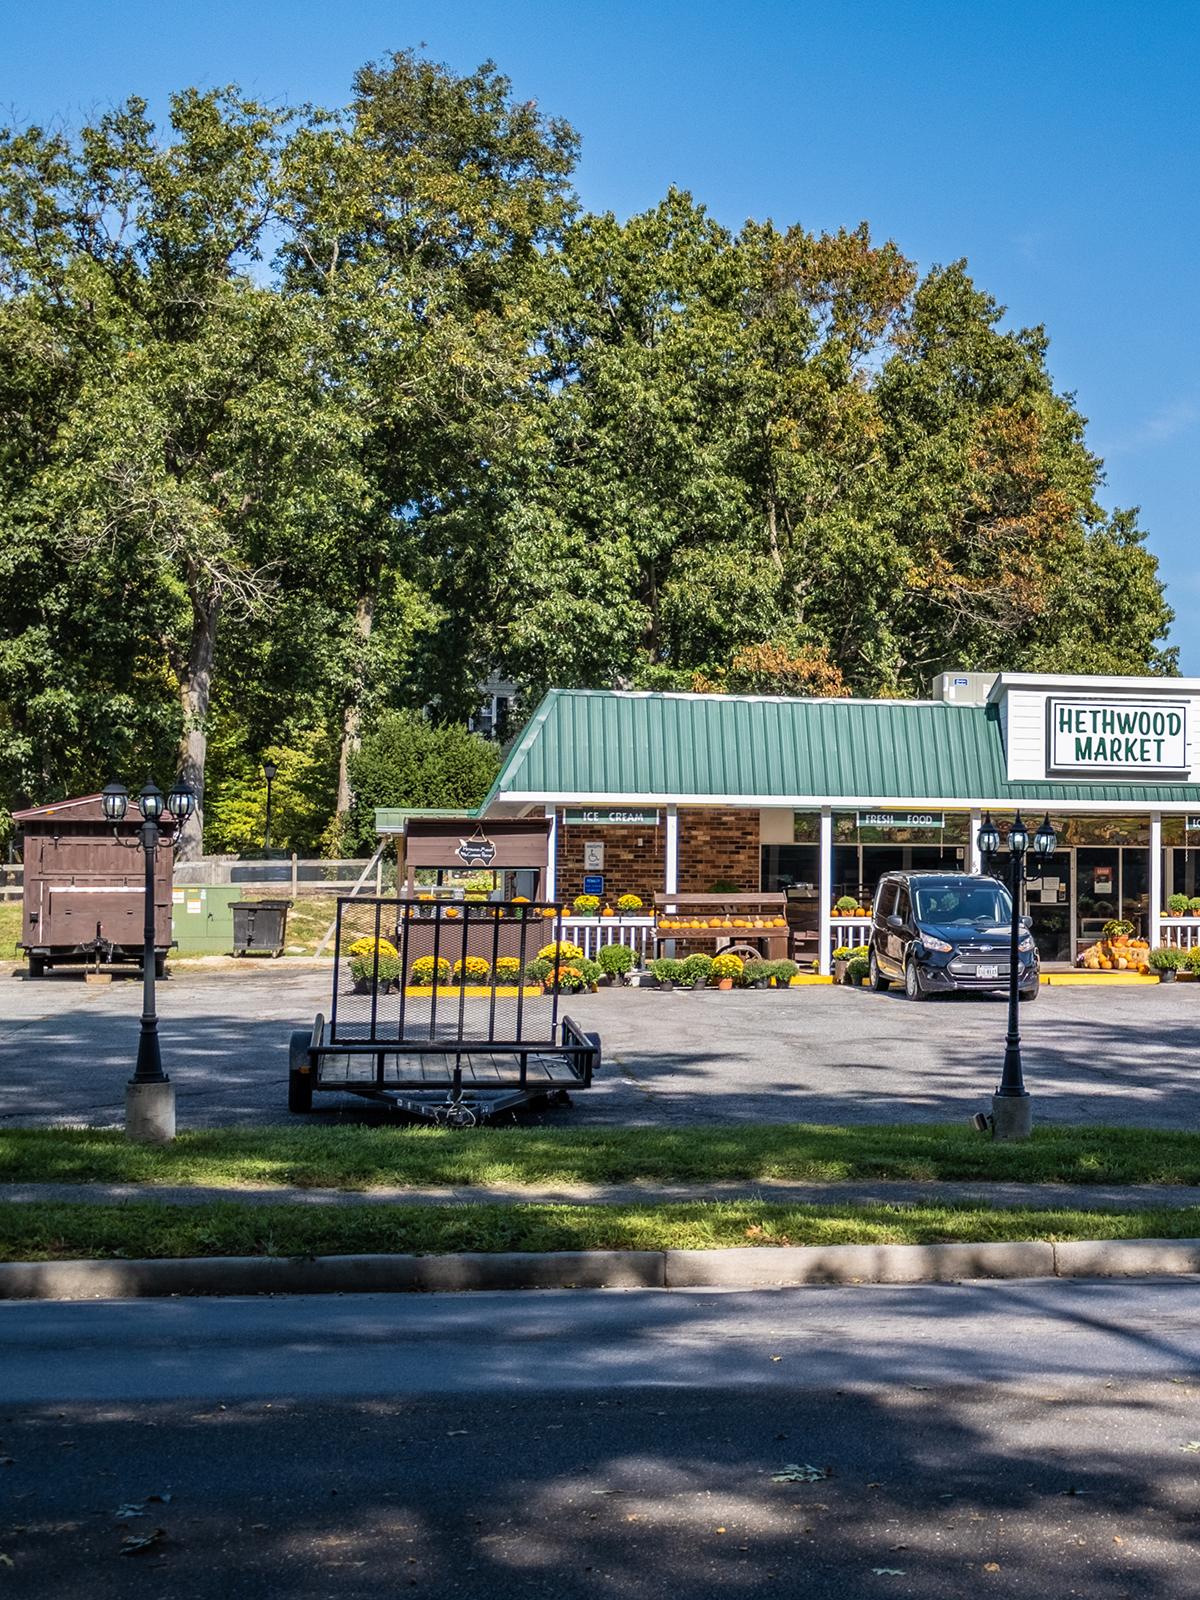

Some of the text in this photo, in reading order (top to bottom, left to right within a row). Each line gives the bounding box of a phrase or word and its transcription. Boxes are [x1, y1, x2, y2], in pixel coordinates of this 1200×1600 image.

[1059, 708, 1182, 736] HETHWOOD
[1074, 736, 1165, 762] MARKET
[583, 812, 644, 822] ICE CREAM
[865, 814, 933, 825] FRESH FOOD
